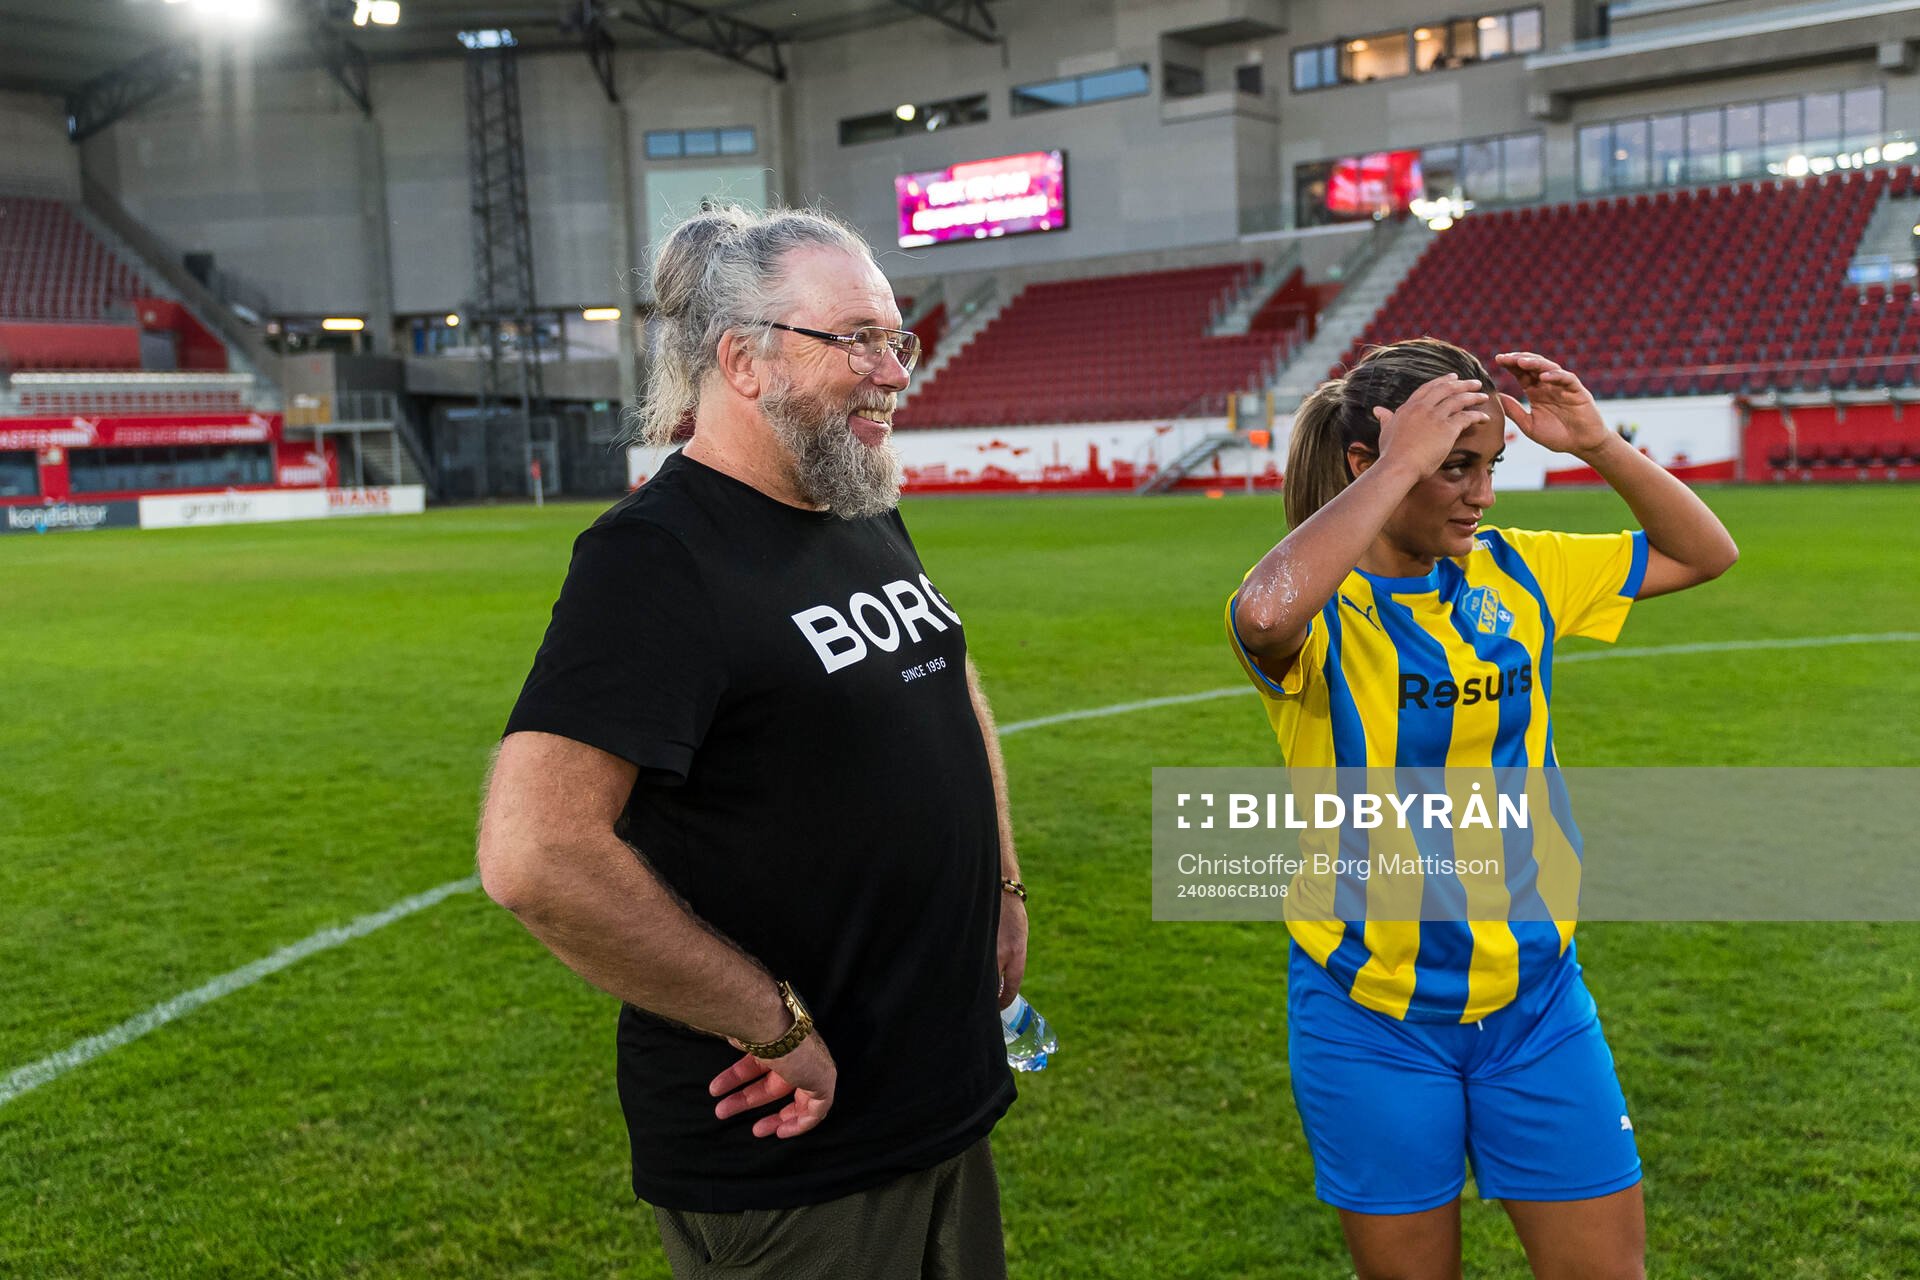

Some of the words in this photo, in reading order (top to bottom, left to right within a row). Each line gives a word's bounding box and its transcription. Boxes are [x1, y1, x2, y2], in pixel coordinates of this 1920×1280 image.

[902, 665, 927, 683] SINCE
[926, 656, 947, 673] 1956
[1399, 664, 1533, 710] Resurs
